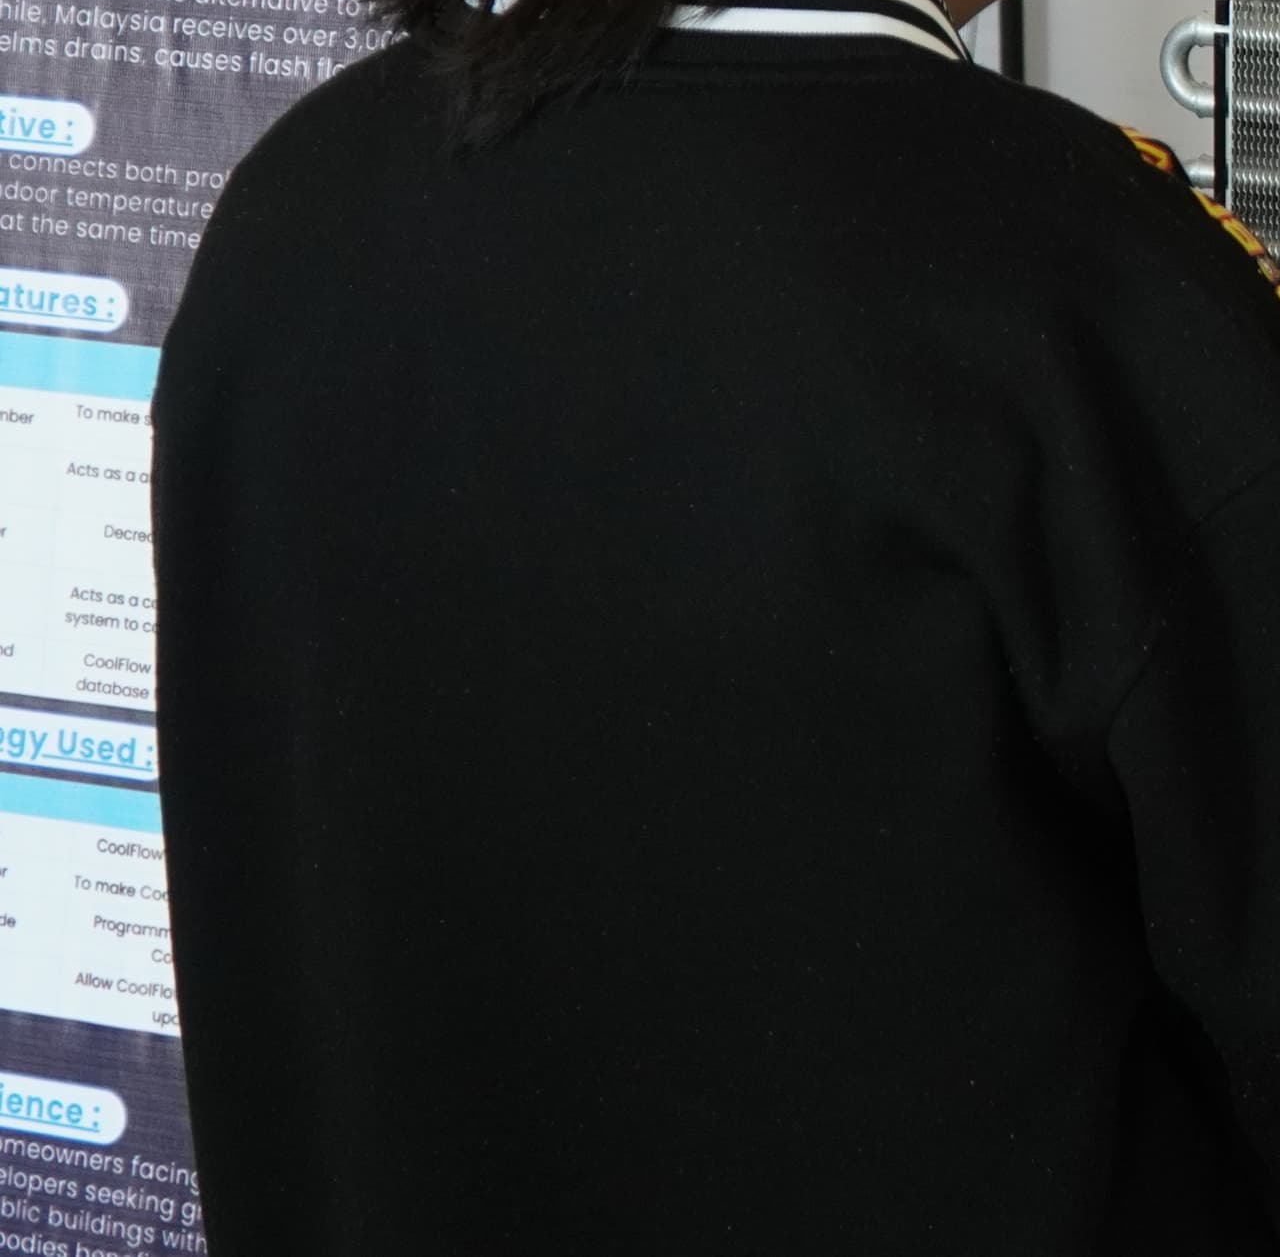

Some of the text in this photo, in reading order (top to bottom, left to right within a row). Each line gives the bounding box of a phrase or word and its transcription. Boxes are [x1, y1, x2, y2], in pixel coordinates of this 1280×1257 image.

[55, 4, 165, 36] Malaysia
[173, 17, 275, 43] receives
[283, 26, 337, 47] over
[155, 48, 242, 72] causes
[250, 51, 309, 79] flash
[9, 153, 118, 179] connects
[125, 161, 177, 186] both
[67, 186, 213, 219] temperature
[0, 213, 201, 249] at the same time
[76, 404, 93, 419] To
[97, 409, 140, 425] make
[66, 462, 99, 478] Acts
[104, 468, 121, 480] as
[125, 471, 135, 482] a
[70, 587, 138, 608] Acts as a
[65, 611, 138, 631] system to
[83, 653, 152, 674] CoolFlow
[76, 677, 149, 699] database
[0, 726, 48, 760] gy
[58, 729, 137, 764] Used
[97, 838, 163, 860] CoolFlow
[74, 875, 91, 891] To
[95, 881, 136, 898] make
[75, 971, 177, 1000] Allow CoolFlo
[0, 1137, 124, 1175] meowners
[85, 1183, 174, 1222] seeking
[48, 1205, 155, 1247] buildings
[163, 1229, 208, 1254] with
